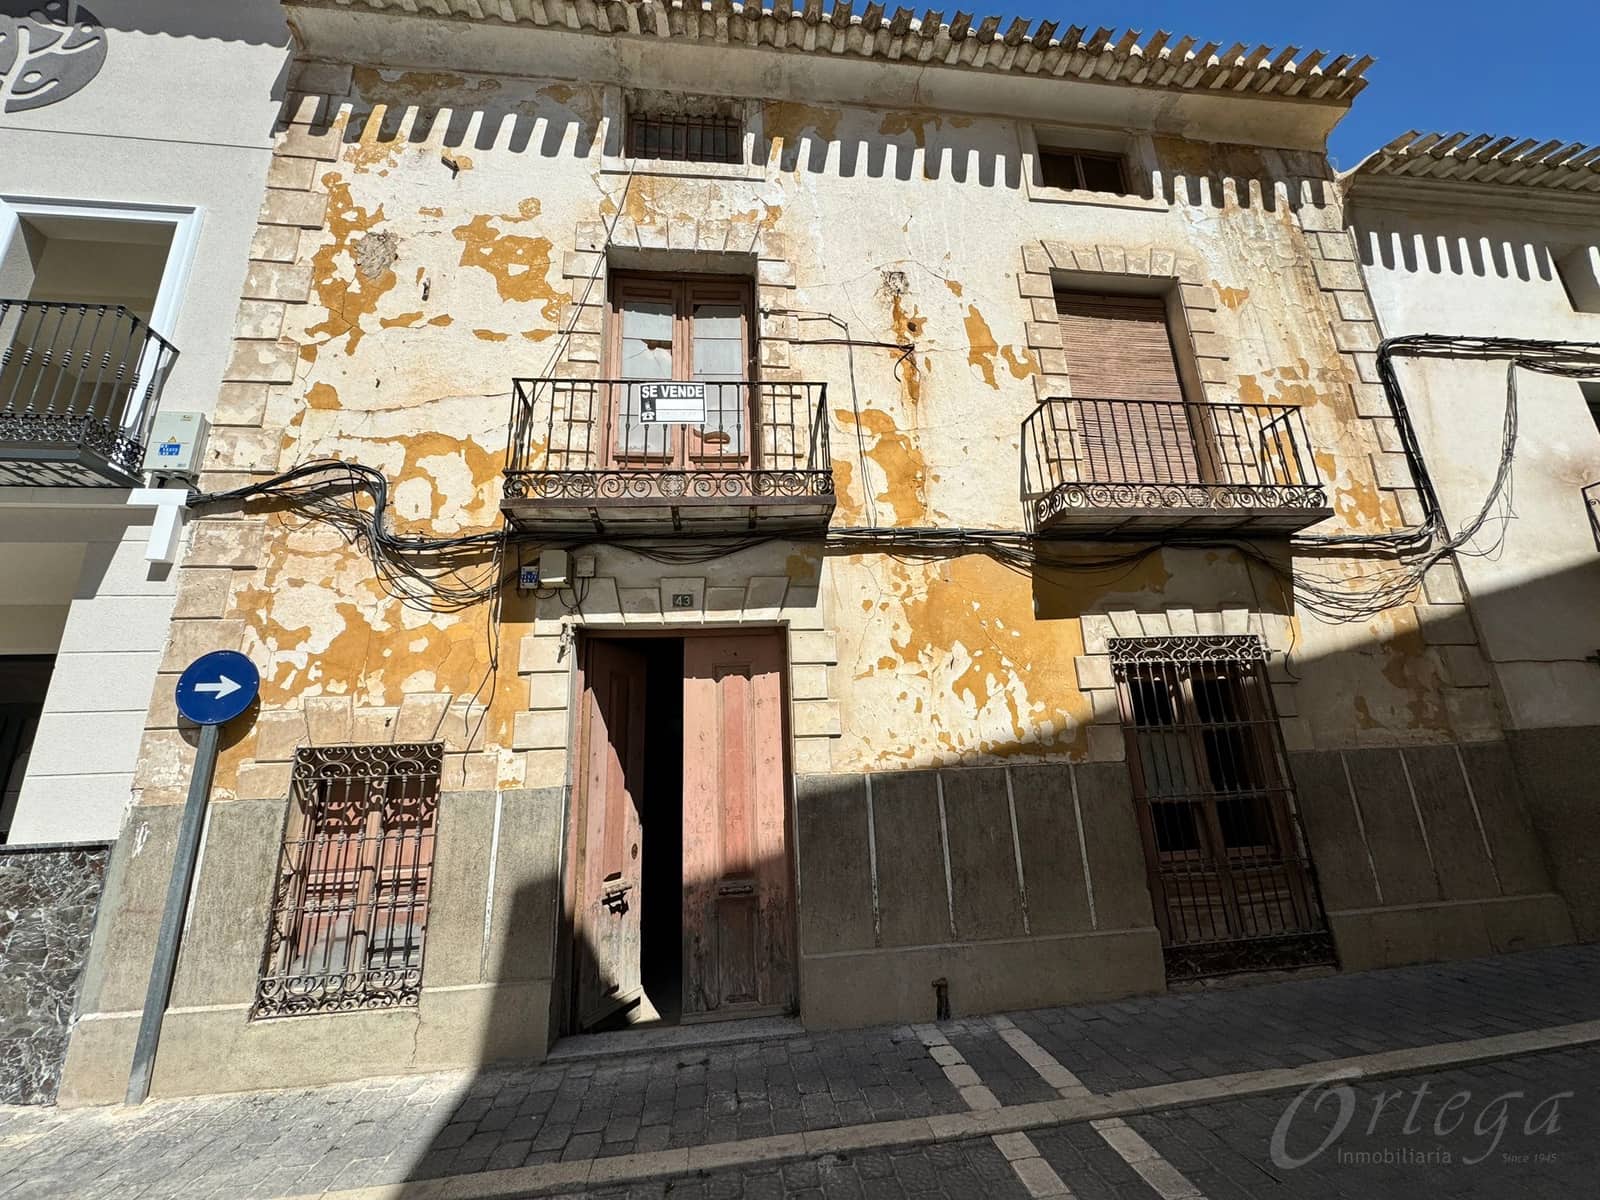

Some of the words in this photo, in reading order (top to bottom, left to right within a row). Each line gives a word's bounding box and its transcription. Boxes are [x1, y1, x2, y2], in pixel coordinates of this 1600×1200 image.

[641, 385, 658, 398] SE
[660, 385, 703, 398] VENDE
[673, 594, 691, 606] 43
